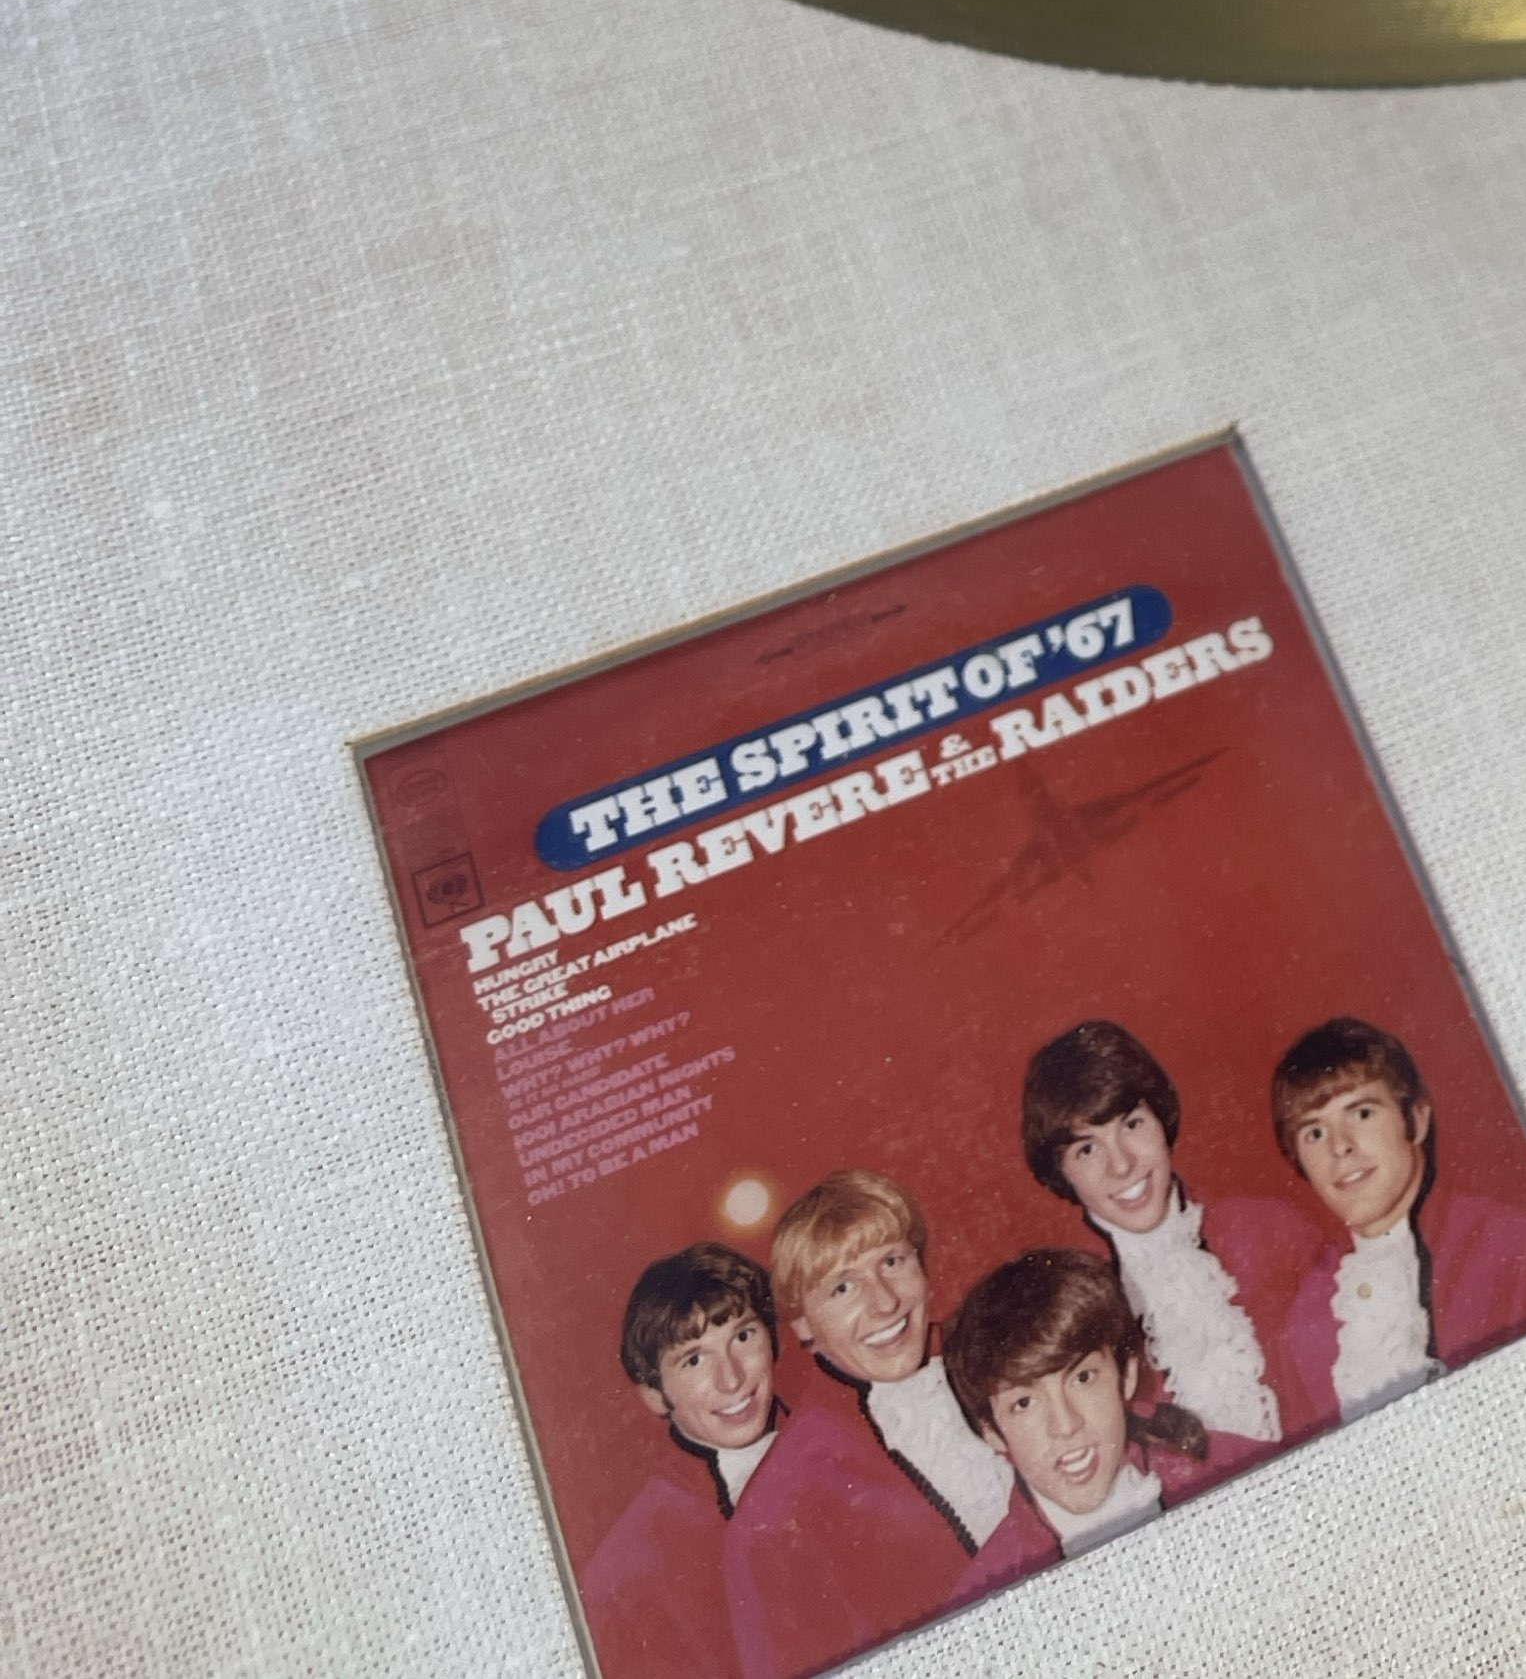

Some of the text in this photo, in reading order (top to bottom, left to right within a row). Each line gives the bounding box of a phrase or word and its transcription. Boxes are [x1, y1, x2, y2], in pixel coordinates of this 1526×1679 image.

[568, 597, 1136, 853] THE SPIRIT OF '67
[990, 616, 1274, 761] RAIDERS
[930, 745, 998, 787] THE
[938, 733, 974, 760] &
[459, 749, 932, 973] PAUL REVERE
[472, 950, 558, 995] HUNGRY
[477, 913, 698, 1011] THE GREAT AIRPLANE
[486, 985, 612, 1044] GOOD THING
[491, 982, 569, 1023] STRIKE
[494, 1036, 535, 1064] ALL
[538, 1006, 607, 1044] ABOUT
[496, 1039, 572, 1081] LOUISE
[501, 1011, 690, 1100] WHY? WHY? WHY?
[508, 1052, 670, 1130] OUR CANDIDATE
[560, 1079, 655, 1131] ARABIAN
[657, 1045, 737, 1089] NIGHTS
[518, 1085, 692, 1168] UNDECIDED MAN
[523, 1094, 713, 1189] IN MY COMMUNITY
[568, 1167, 597, 1189] TO
[598, 1153, 630, 1176] BE
[632, 1145, 649, 1164] A
[648, 1122, 699, 1155] MAN
